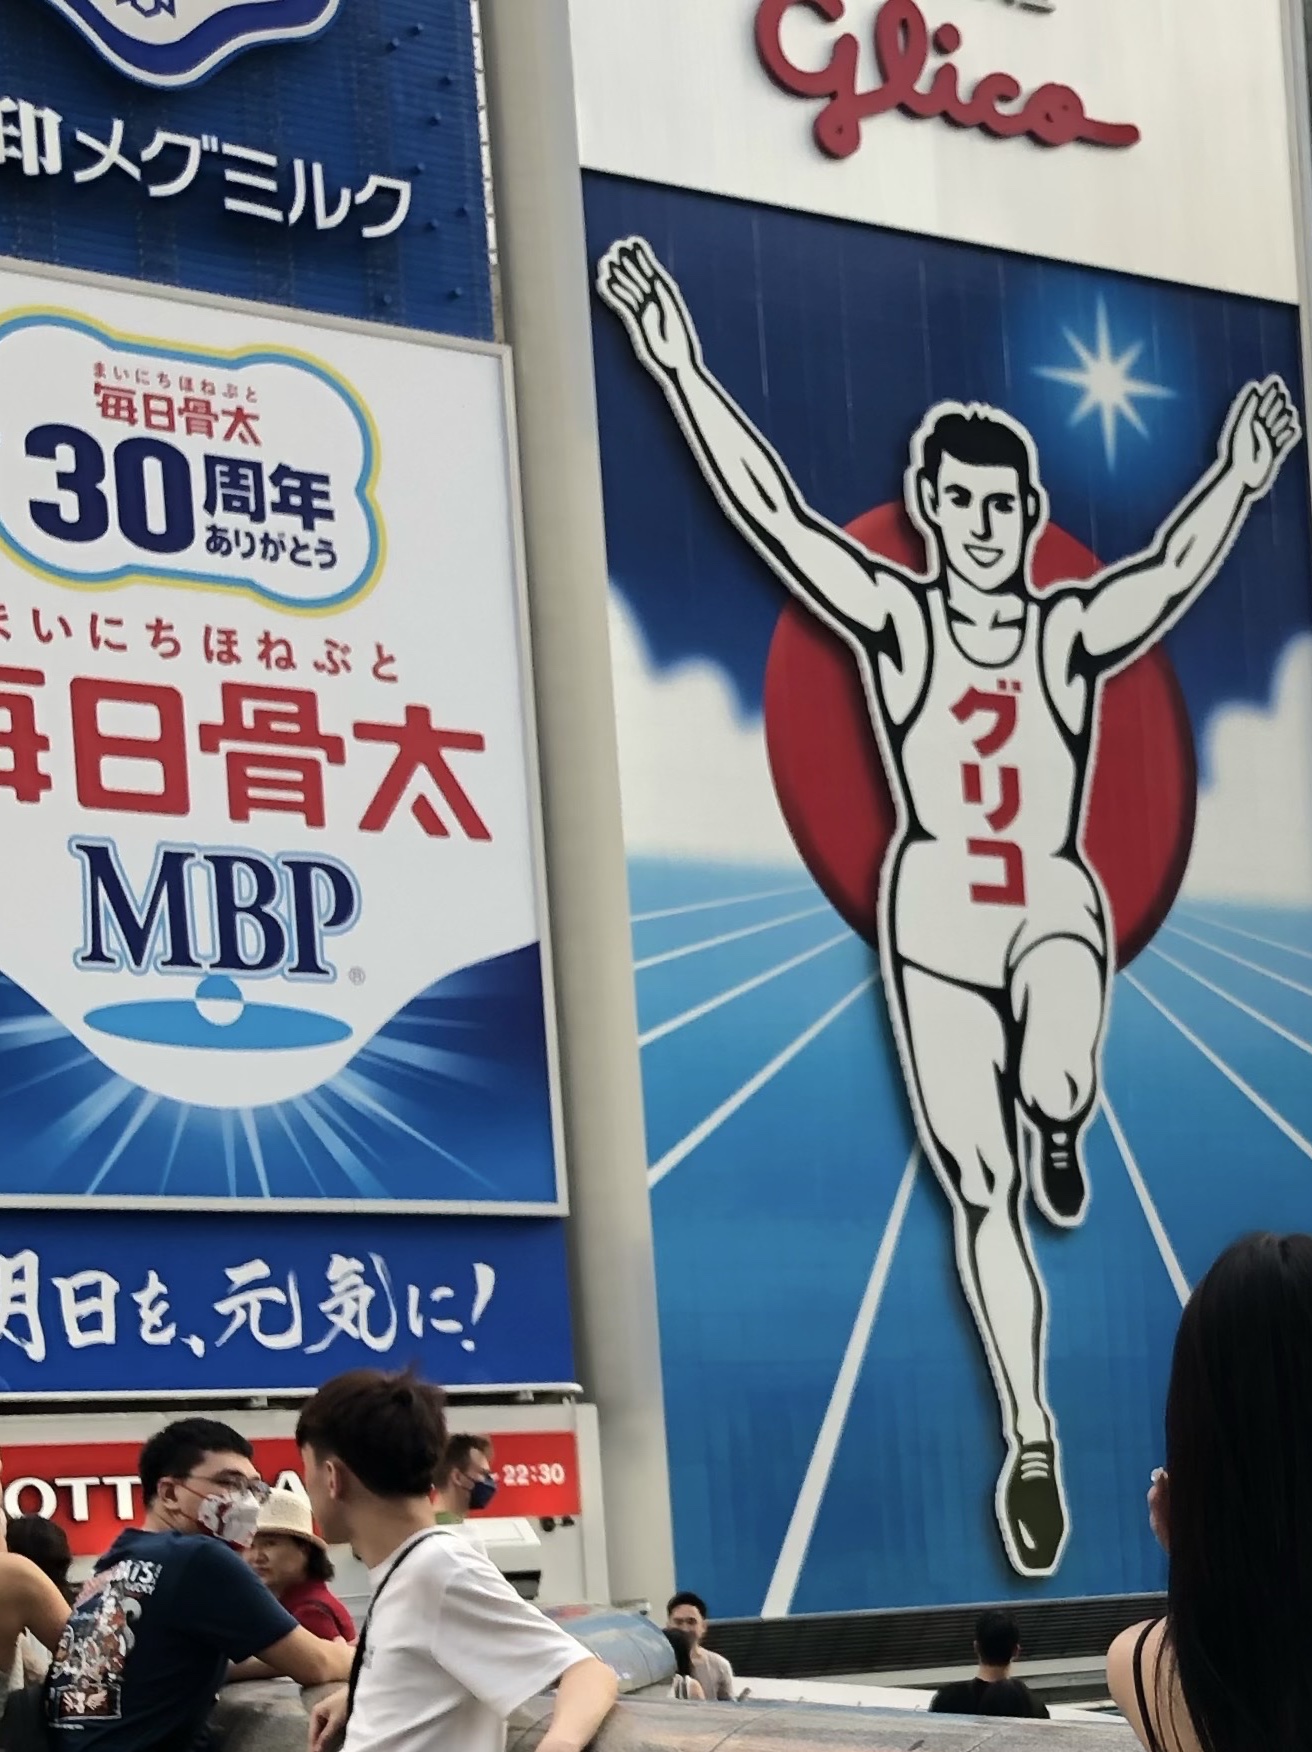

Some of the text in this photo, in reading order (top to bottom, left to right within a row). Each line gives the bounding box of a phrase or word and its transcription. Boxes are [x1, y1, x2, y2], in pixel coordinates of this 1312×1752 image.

[93, 361, 258, 403] まいにちほねぶと
[94, 382, 262, 446] 毎日骨太
[204, 524, 338, 570] ありがとう
[949, 678, 1027, 907] グリコ
[70, 836, 361, 981] MBP
[502, 1463, 565, 1486] 22:30
